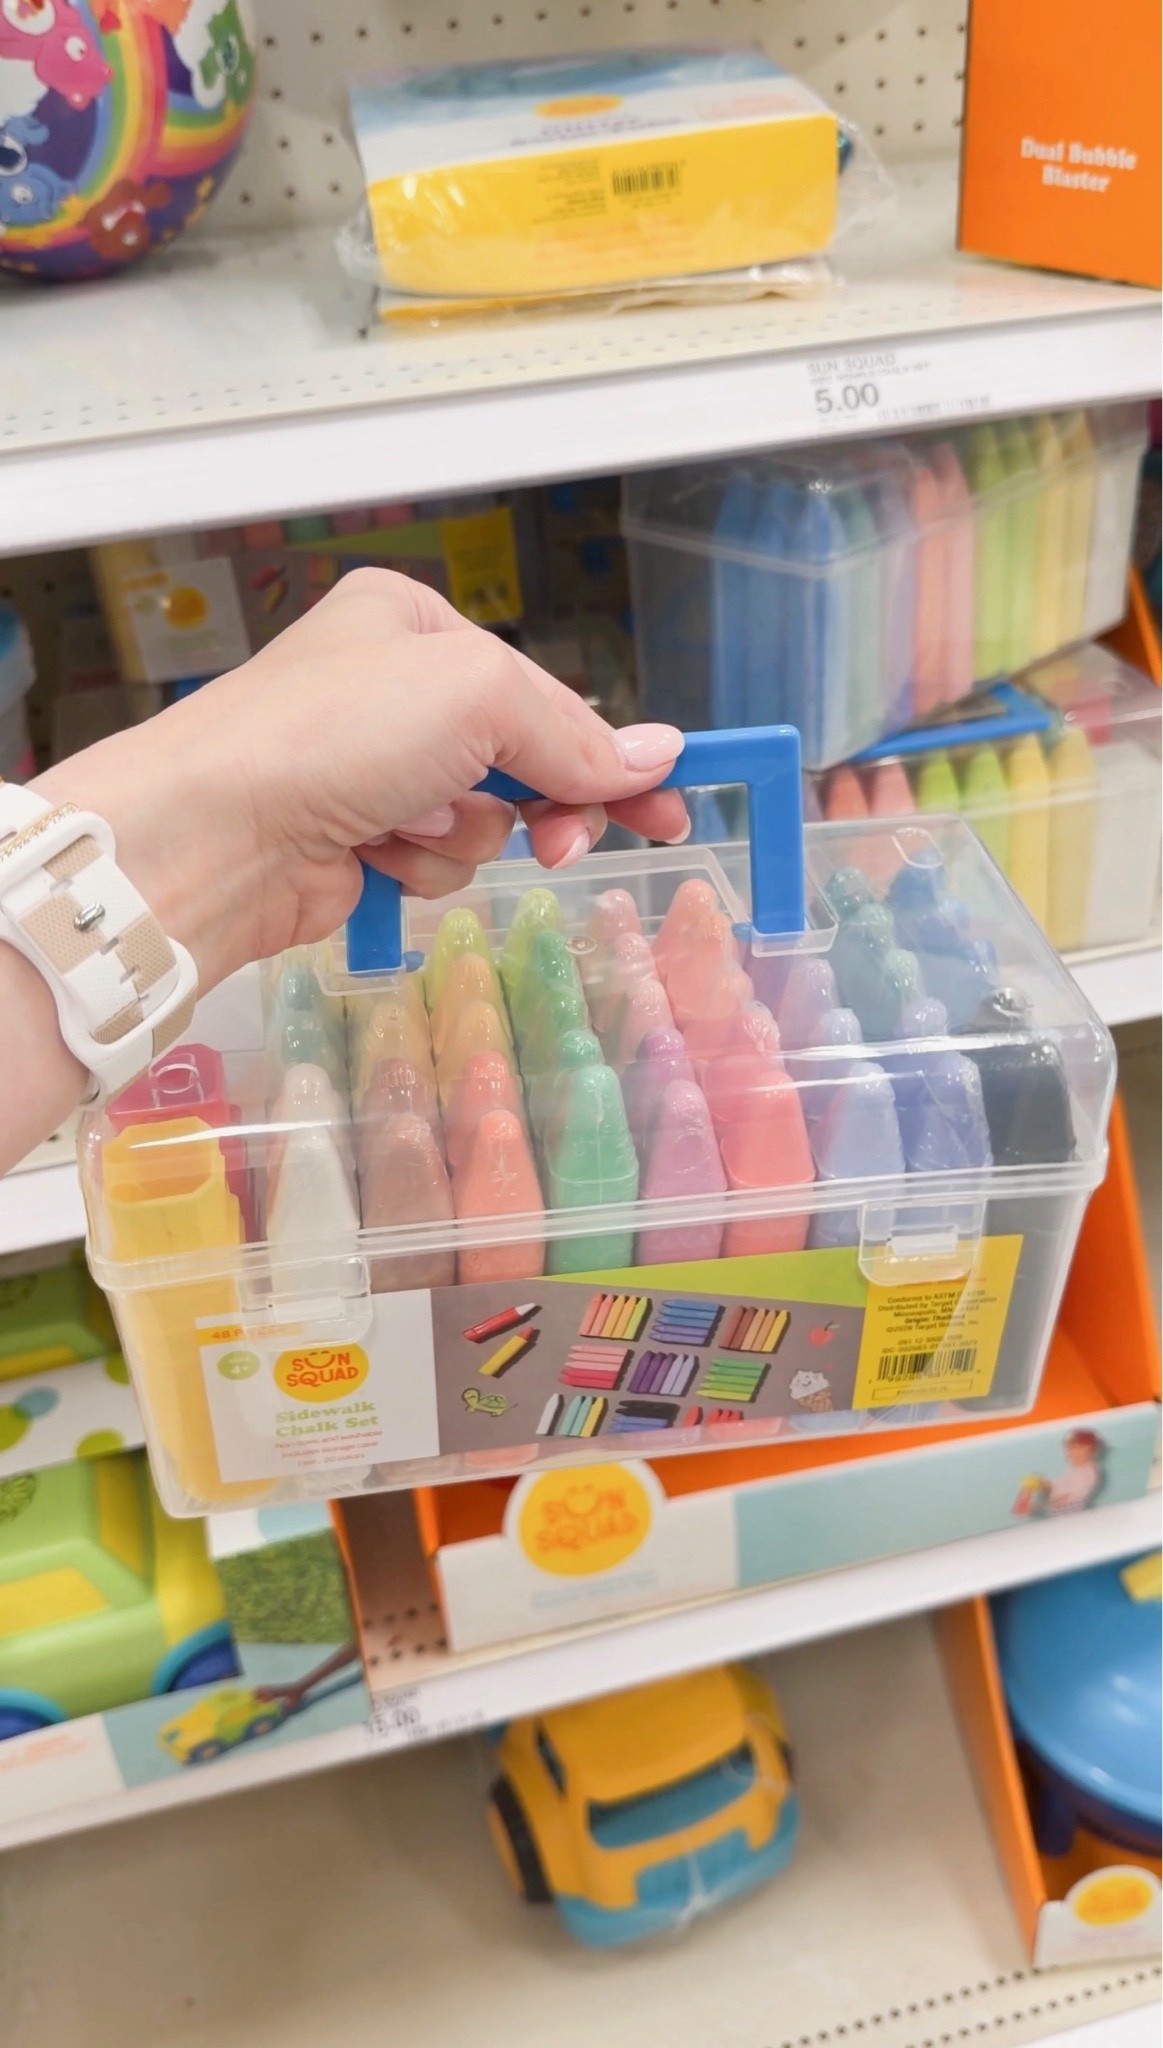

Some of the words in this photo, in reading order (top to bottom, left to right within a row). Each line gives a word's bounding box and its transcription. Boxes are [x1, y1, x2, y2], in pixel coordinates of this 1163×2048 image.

[1020, 136, 1064, 161] Dual
[1069, 141, 1136, 169] Bubble
[1042, 164, 1110, 192] Blaster
[815, 383, 879, 414] 5.00
[878, 1302, 918, 1312] Distributed
[930, 1299, 953, 1308] Target
[933, 1291, 955, 1300] ASTM
[904, 1316, 931, 1326] Origin:
[915, 1323, 937, 1332] Target
[212, 1330, 231, 1339] 48
[291, 1351, 351, 1372] SUN
[286, 1366, 359, 1388] SQUAD
[276, 1401, 376, 1423] Sidewalk
[276, 1422, 339, 1437] Chalk
[345, 1416, 379, 1428] Set
